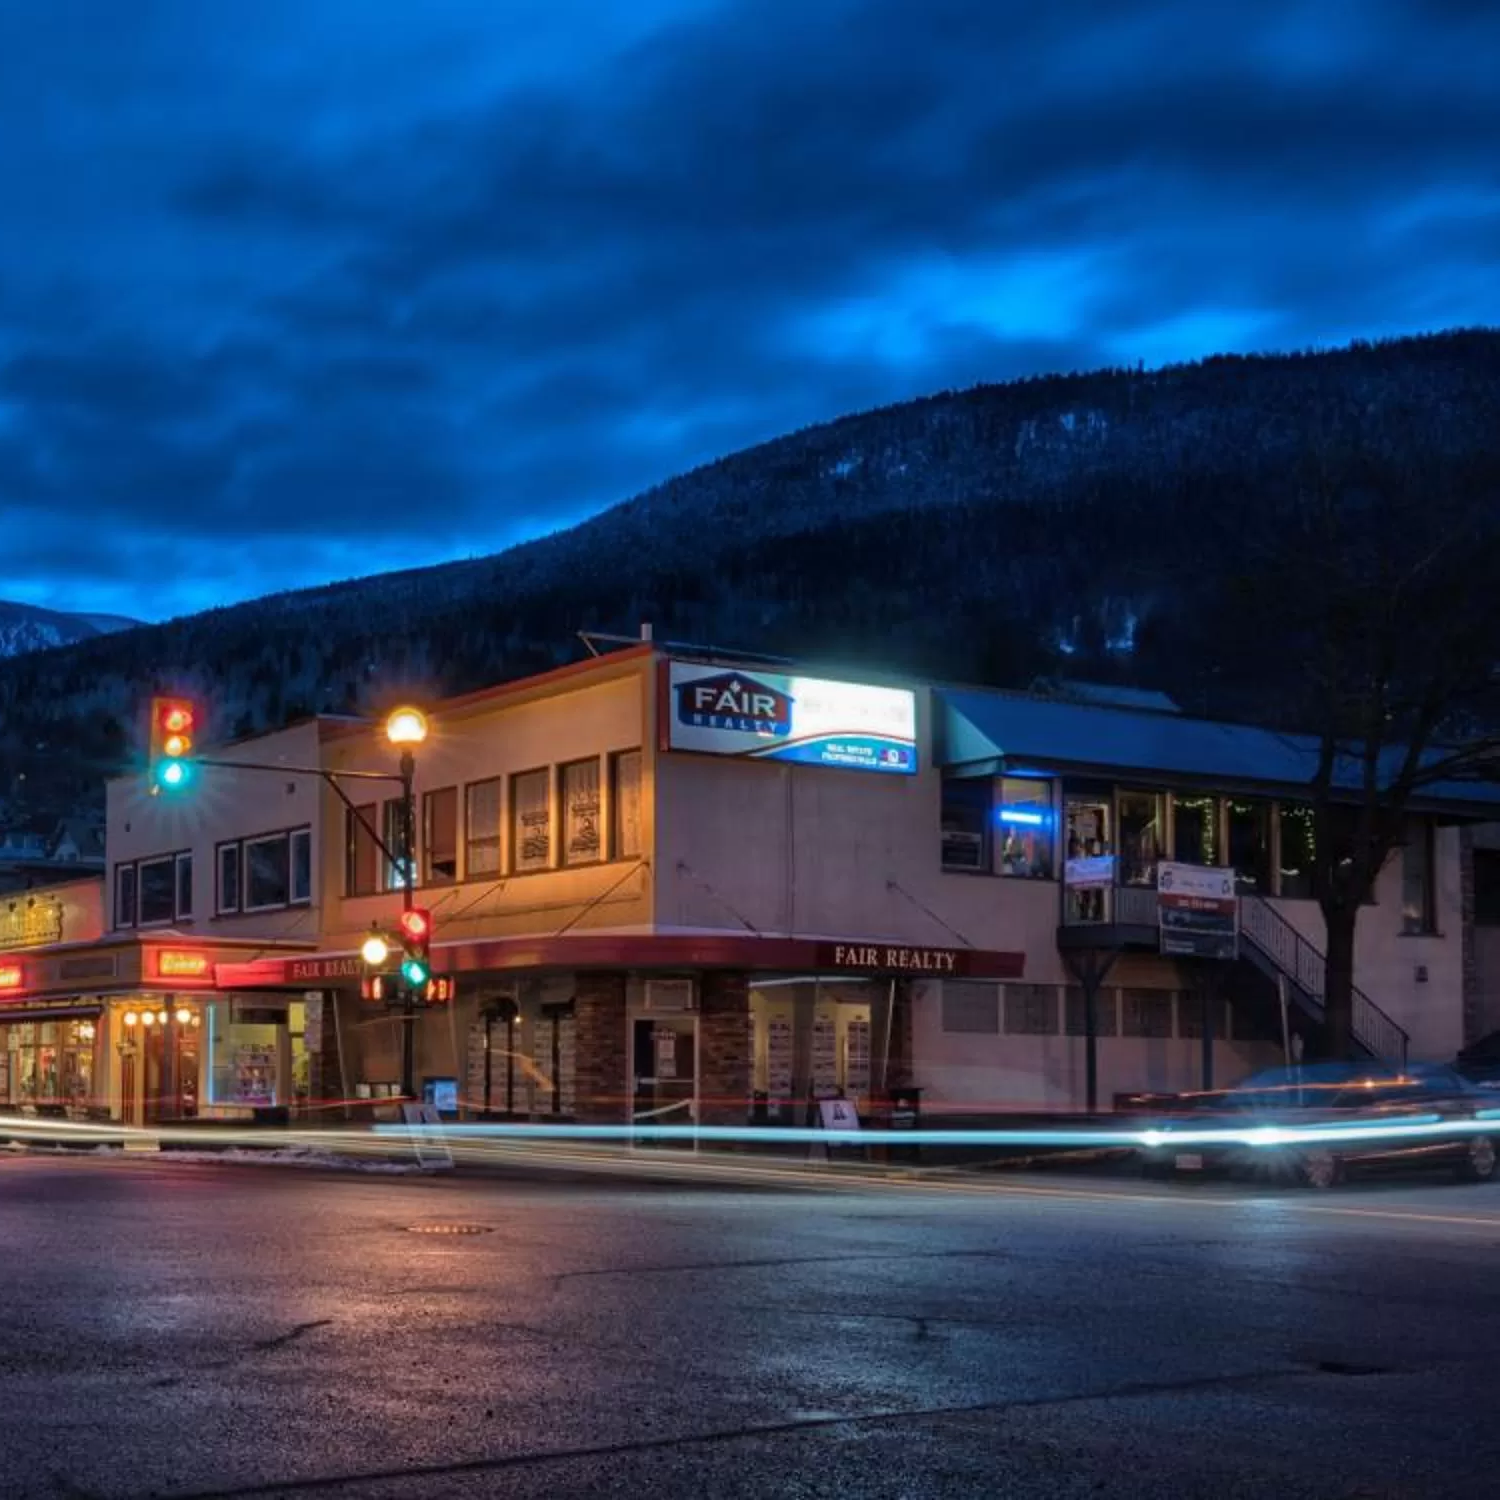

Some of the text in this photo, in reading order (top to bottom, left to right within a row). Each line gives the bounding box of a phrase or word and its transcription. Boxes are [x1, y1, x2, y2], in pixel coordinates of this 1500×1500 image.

[695, 686, 776, 718] FAIR
[693, 712, 777, 734] REALTY
[324, 957, 366, 977] REALT
[835, 945, 956, 971] FAIR REALTY
